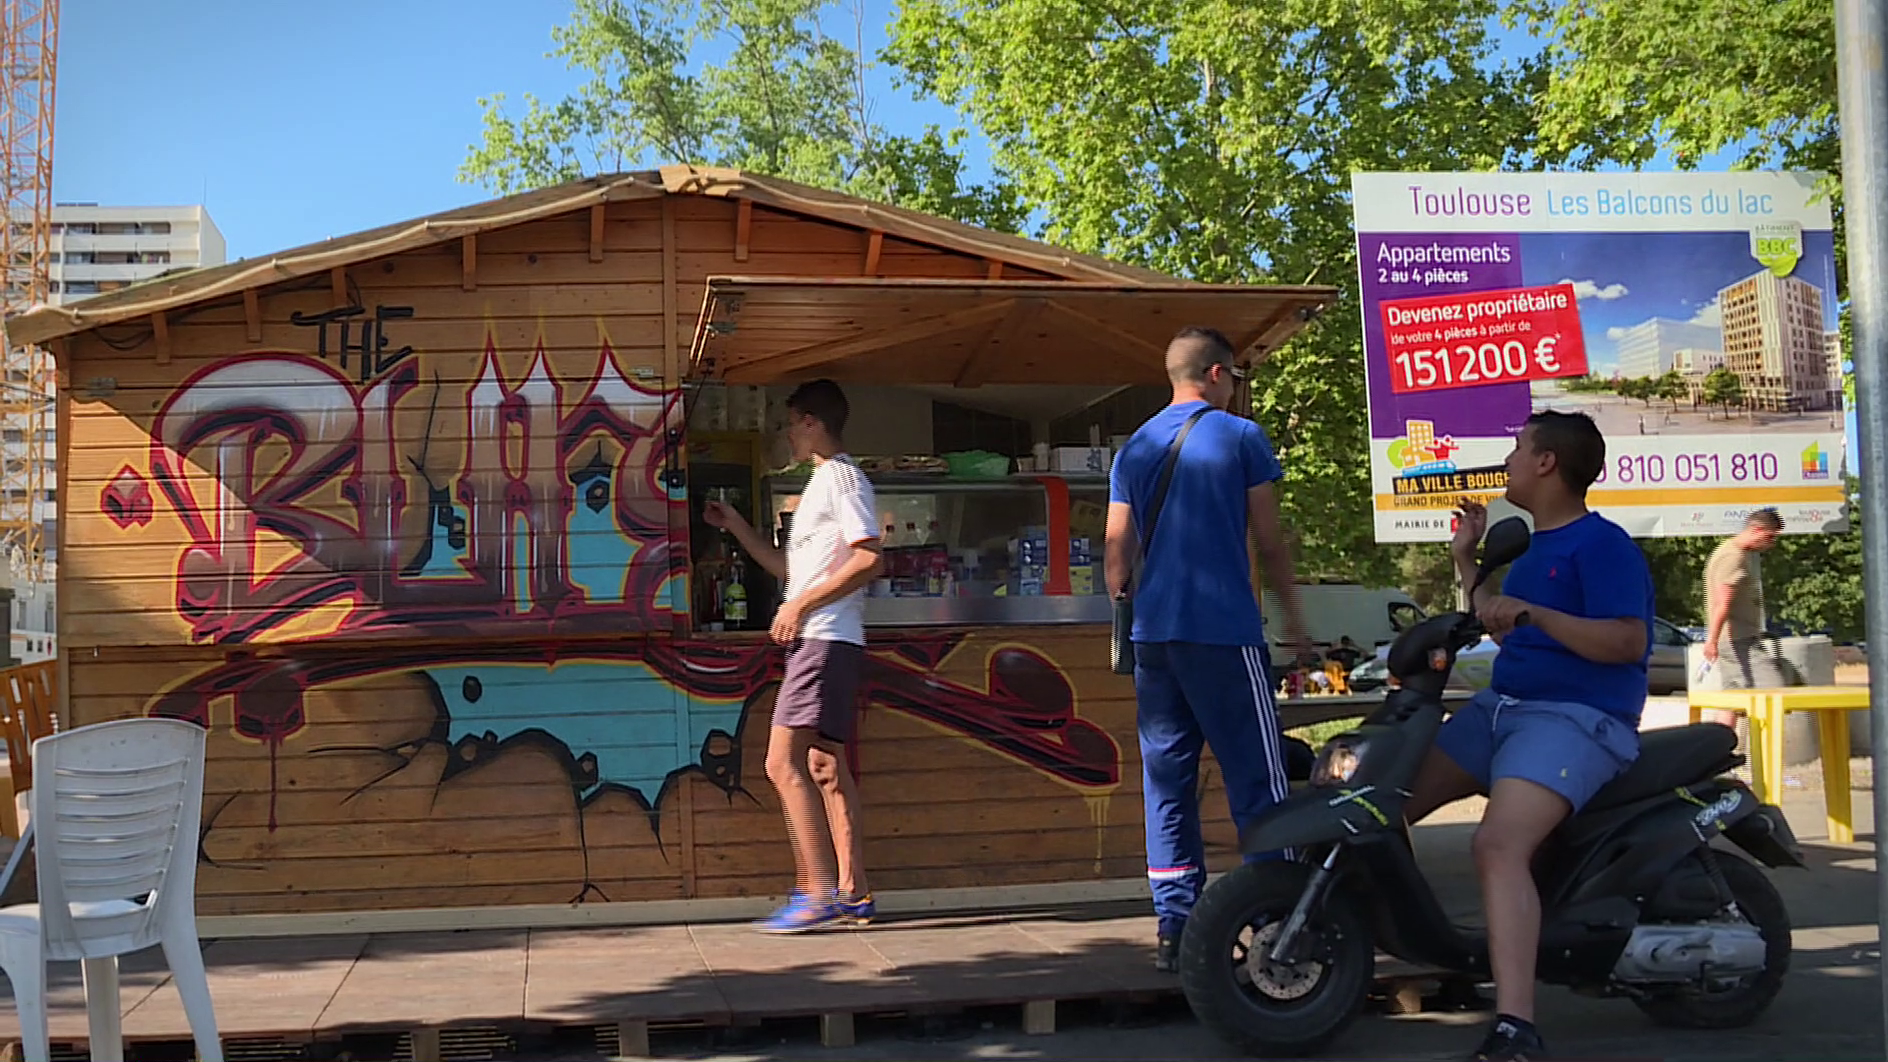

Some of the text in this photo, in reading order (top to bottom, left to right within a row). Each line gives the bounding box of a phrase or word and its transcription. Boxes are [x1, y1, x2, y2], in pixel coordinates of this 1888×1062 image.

[1408, 185, 1773, 217] Toulouse Les Balcons du lac
[1377, 242, 1511, 267] Appartements
[1756, 237, 1797, 256] BBC
[1378, 268, 1469, 286] 2 au 4 pièces
[1387, 290, 1568, 326] Devenez propriétaire
[291, 305, 414, 381] THE
[1406, 331, 1432, 344] votre
[1434, 329, 1442, 341] 4
[1444, 326, 1479, 343] pièces
[1480, 324, 1487, 335] à
[1488, 320, 1516, 338] partir
[1518, 319, 1531, 331] de
[1617, 454, 1665, 483] 810
[1675, 453, 1720, 482] 051
[1731, 452, 1779, 481] 810
[1396, 479, 1419, 493] MA
[1421, 475, 1462, 492] VILLE
[1393, 496, 1427, 507] GRAND
[1430, 494, 1466, 507] PROJE
[1395, 520, 1429, 529] MAIRIE
[1433, 520, 1444, 528] DE
